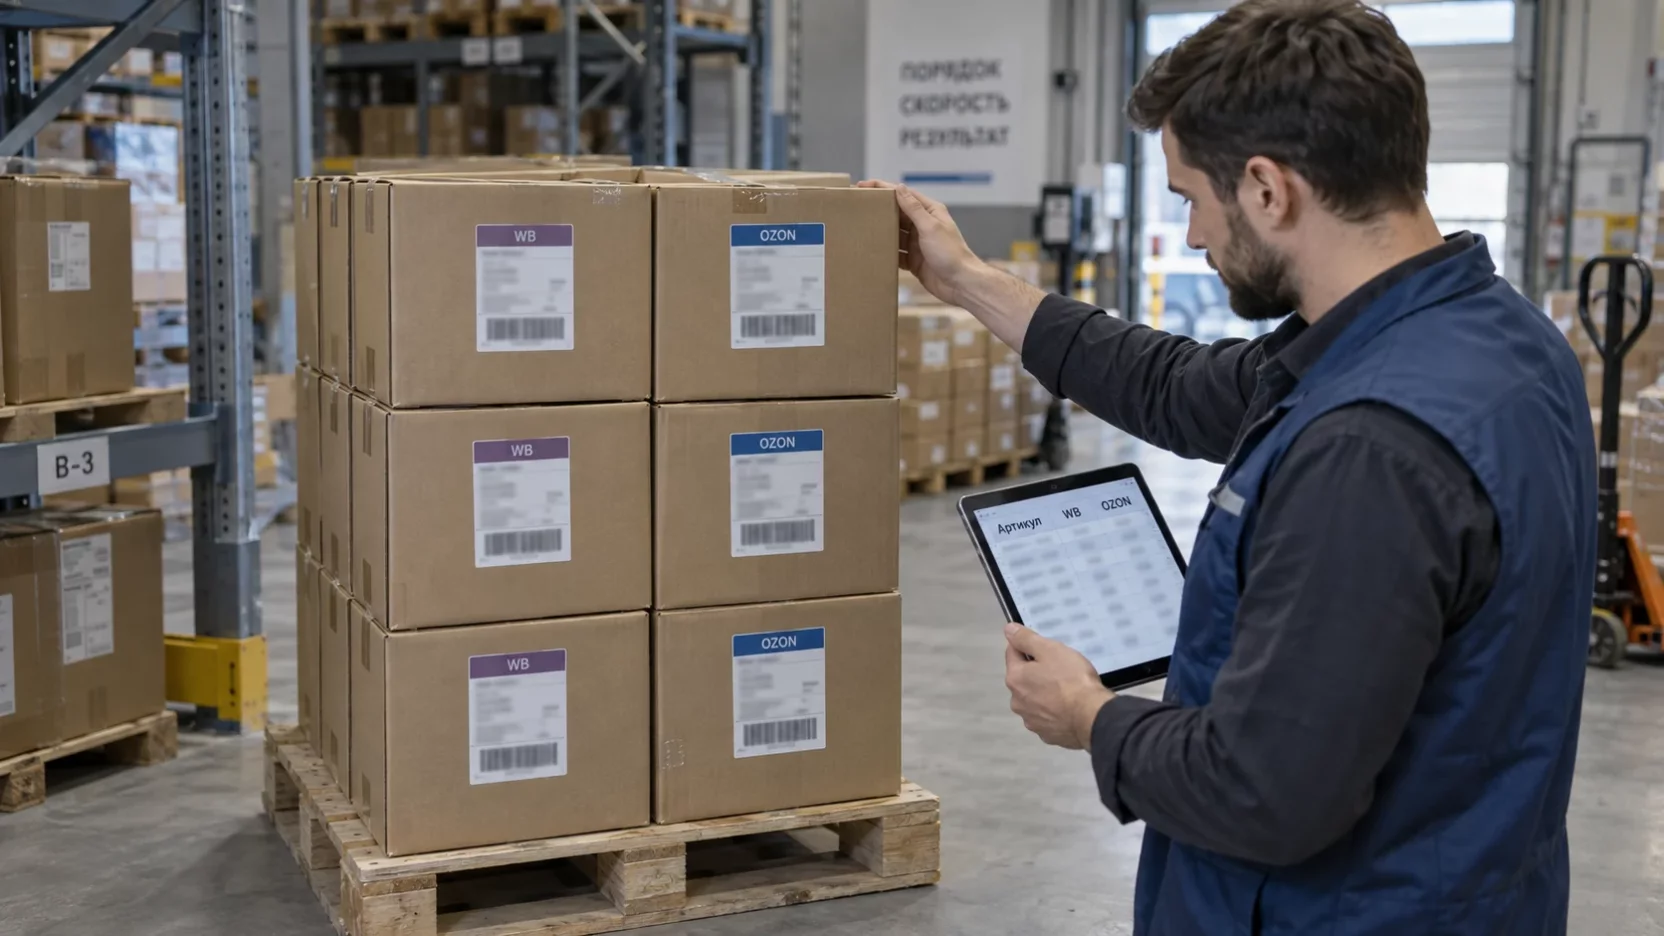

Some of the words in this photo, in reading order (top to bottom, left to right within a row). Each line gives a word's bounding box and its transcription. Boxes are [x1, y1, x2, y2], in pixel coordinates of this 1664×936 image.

[900, 58, 1002, 84] ПОРЯДОК
[899, 92, 1011, 117] СКОРОСТЬ
[899, 126, 1010, 149] РЕЗУЛЬТАТ
[513, 229, 537, 243] WB
[759, 228, 797, 242] OZON
[510, 443, 534, 457] WB
[759, 435, 796, 450] OZON
[55, 450, 94, 480] B-3
[998, 517, 1042, 535] Артикул
[1062, 507, 1082, 519] WB
[1101, 495, 1132, 511] OZON
[761, 635, 797, 650] OZON
[506, 656, 530, 672] WB
